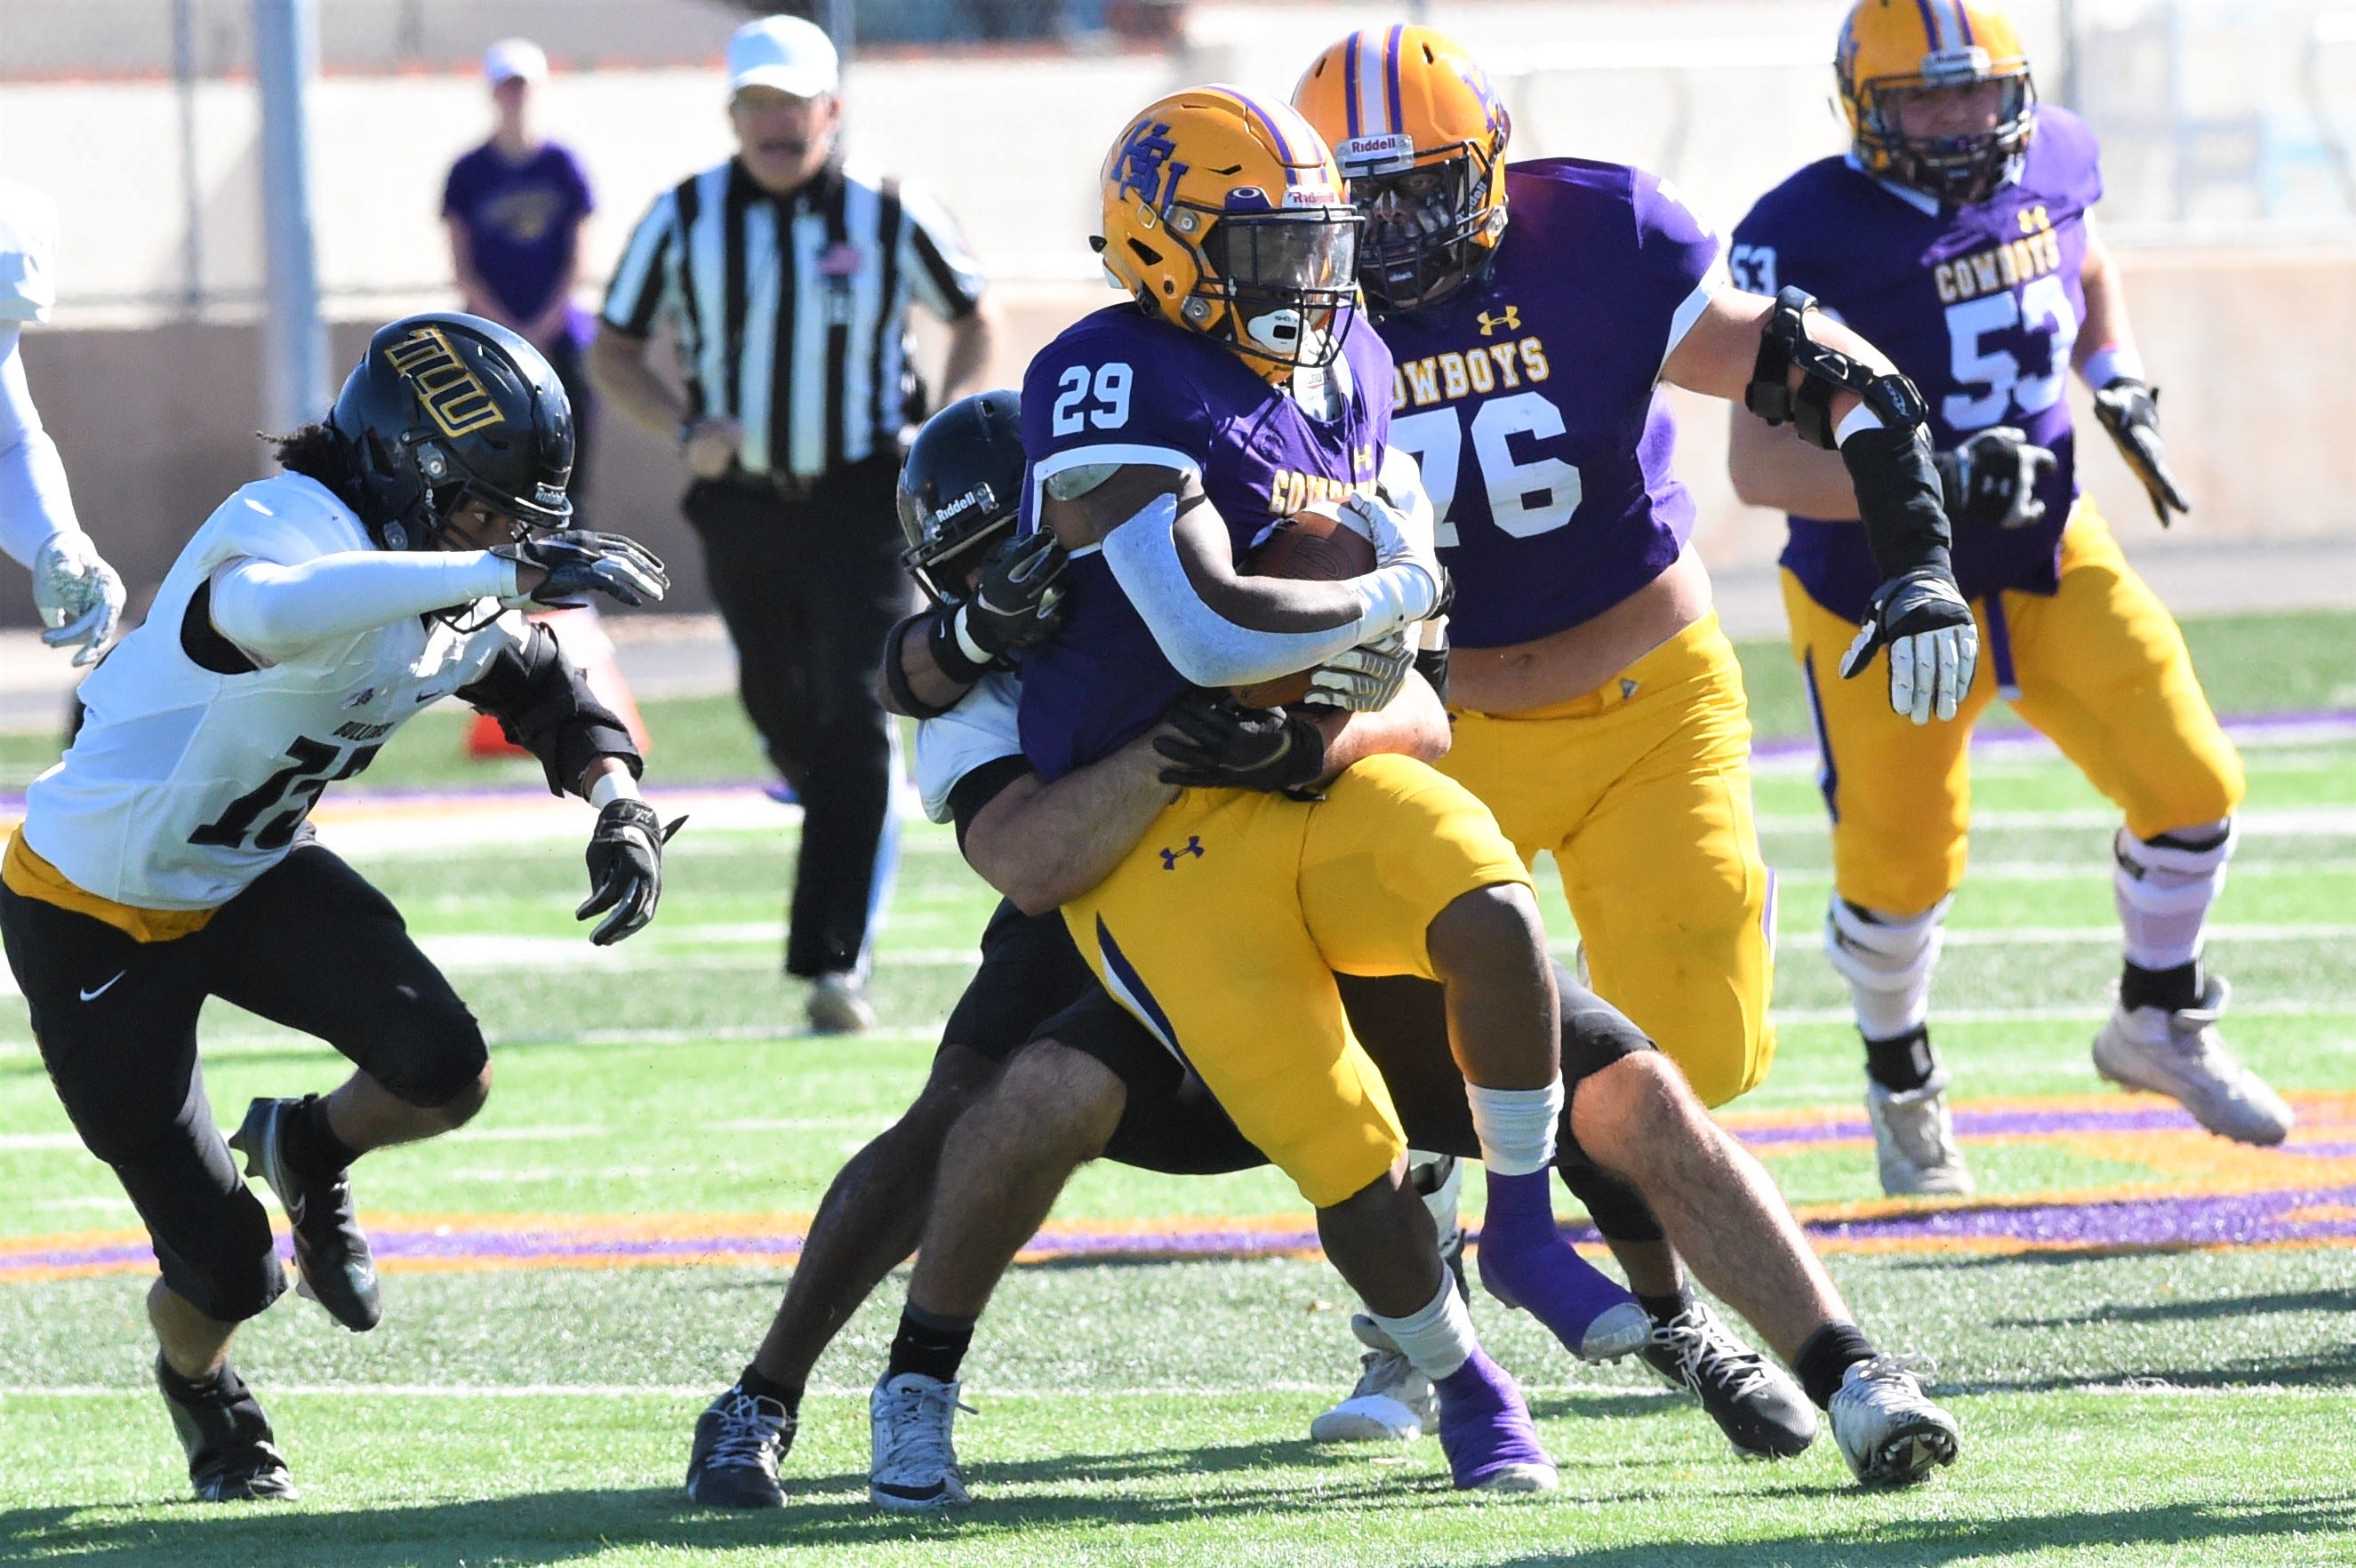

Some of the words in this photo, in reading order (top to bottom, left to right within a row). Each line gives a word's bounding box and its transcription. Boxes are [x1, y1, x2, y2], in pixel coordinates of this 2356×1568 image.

[1351, 137, 1396, 154] Riddell
[1731, 244, 1776, 297] 53
[1934, 228, 2061, 304] COWBOYS
[384, 324, 506, 438] TLU
[1393, 336, 1550, 410] OWBOYS
[1942, 275, 2080, 430] 53
[1053, 363, 1134, 437] 29
[1389, 391, 1583, 548] 76
[935, 491, 976, 523] Riddell
